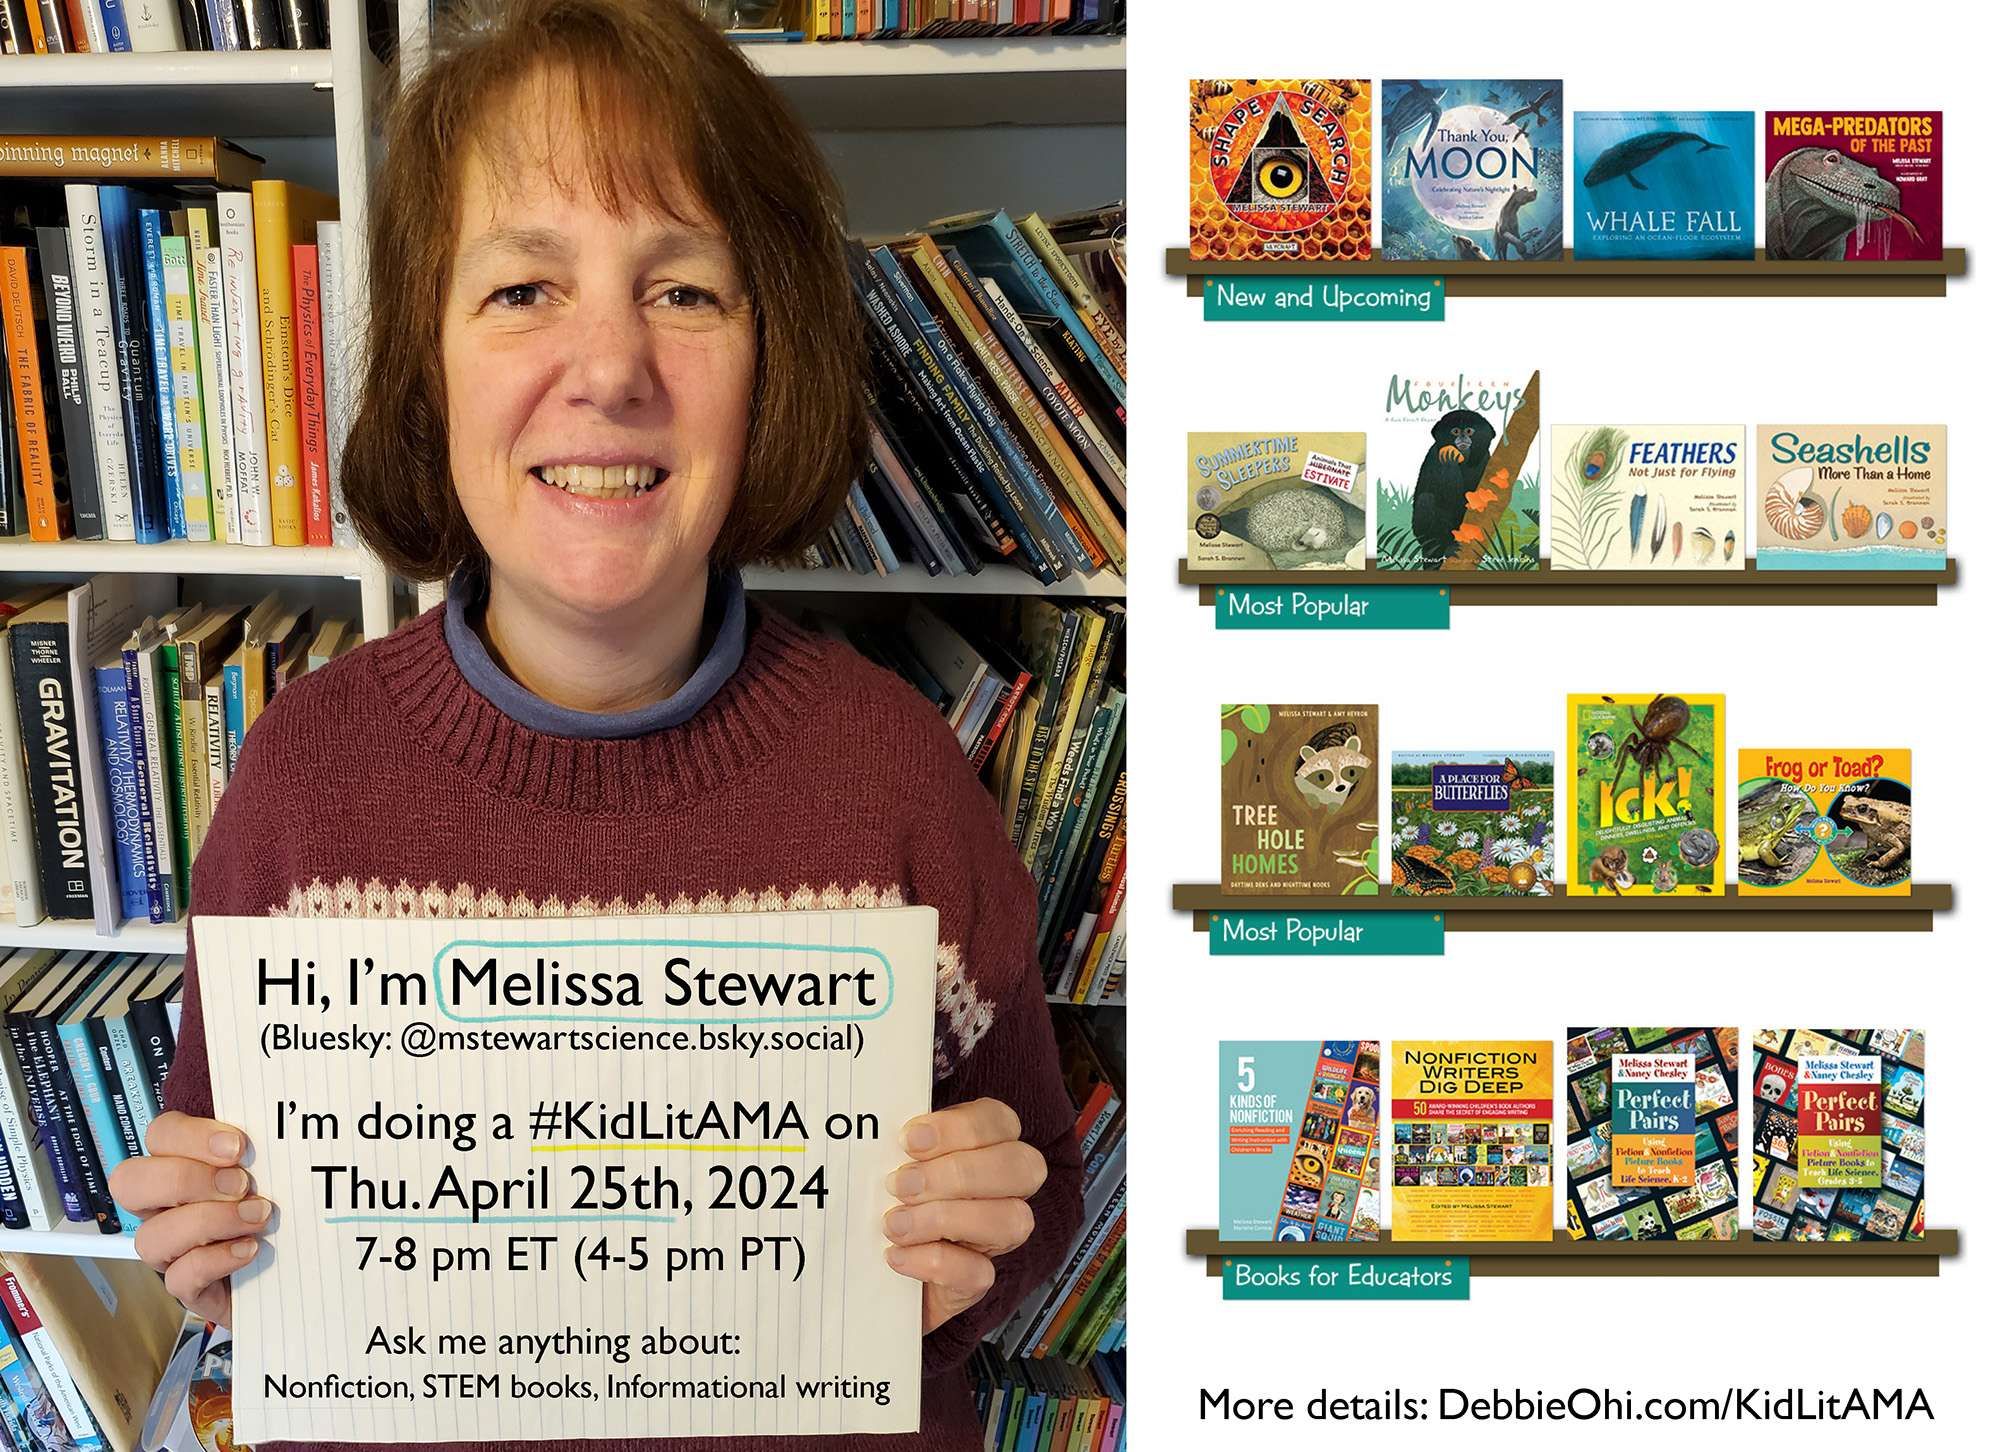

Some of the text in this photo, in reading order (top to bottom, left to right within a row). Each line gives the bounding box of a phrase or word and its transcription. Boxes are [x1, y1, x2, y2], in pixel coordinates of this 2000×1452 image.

[1213, 99, 1262, 168] SHAPE
[1300, 99, 1350, 186] SEARCH
[1438, 128, 1508, 143] Thank You,
[1773, 117, 1932, 137] MEGA-PREDATORS
[71, 141, 139, 165] magnet
[172, 139, 181, 172] MITCHELL
[1851, 139, 1931, 153] OF THE PAST
[1404, 146, 1539, 179] MOON
[1232, 203, 1329, 213] MELISSA STEWART
[1586, 211, 1741, 232] WHALE FALL
[8, 259, 18, 289] DAVID
[81, 214, 112, 393] Storm in a Teacup
[1218, 284, 1431, 312] New and Upcoming
[12, 291, 23, 338] DEUTSCH
[51, 274, 74, 364] BEYOND WEIRD
[866, 289, 913, 359] WASHED ASHORE
[995, 295, 1054, 378] Hands-On Science
[18, 349, 27, 370] THE
[263, 288, 280, 443] and Schrödinger's Cat
[280, 315, 294, 418] Einstein's Dice
[302, 269, 319, 453] The Physics of Everyday Things
[20, 375, 34, 416] FABRIC
[61, 369, 72, 400] BALL
[69, 368, 82, 405] PHILIP
[913, 338, 971, 424] FINDING FAMILY
[1042, 386, 1091, 450] COYOTE MOON
[1386, 374, 1526, 447] Monkeys
[26, 421, 37, 434] OF
[28, 439, 42, 486] REALITY
[1195, 436, 1298, 478] SUMMERTIME
[1629, 442, 1737, 464] FEATHERS
[1771, 432, 1930, 464] Seashells
[1216, 456, 1290, 492] SLEEPERS
[1303, 469, 1350, 490] ESTIVATE
[1629, 467, 1736, 480] Not Just for Flying
[1818, 467, 1931, 480] More Than a Home
[1229, 592, 1369, 621] Most Popular
[207, 694, 222, 769] RELATIVITY
[38, 677, 84, 869] GRAVITATION
[1439, 774, 1500, 784] A PLACE FOR
[1766, 754, 1884, 784] Frog or Toad?
[105, 738, 129, 847] AND COSMOLOGY
[114, 701, 145, 878] RELATIVITY, THERMODYNAMICS
[1042, 741, 1083, 833] Weeds Find Way
[1434, 784, 1508, 800] BUTTERFLIES
[1780, 783, 1870, 793] How Do You Know?
[1233, 805, 1277, 825] TREE
[1258, 829, 1304, 850] HOLE
[1233, 854, 1298, 874] HOMES
[1223, 918, 1364, 947] Most Popular
[259, 958, 876, 1013] Hi, I'm Melissa Stewart
[261, 1022, 863, 1058] (Bluesky: @mstewartscience.bsky.social)
[1238, 1056, 1256, 1092] 5
[1405, 1051, 1537, 1065] NONFICTION
[1424, 1067, 1519, 1079] WRITERS
[1618, 1059, 1688, 1068] Melissa Stewart
[1230, 1095, 1276, 1108] KINDS OF
[1420, 1081, 1524, 1093] DIG DEEP
[1616, 1088, 1691, 1111] Perfect
[39, 1030, 98, 1195] HOOPER AT THE EDGE OF TIME
[278, 1101, 878, 1151] I'm doing a #KidLitAMA on
[1230, 1110, 1293, 1123] NONFICTION
[1629, 1110, 1679, 1131] Pairs
[311, 1165, 828, 1223] Thu. April 25th, 2024
[356, 1236, 805, 1281] 7-8 pm ET (4-5 pm PT)
[1236, 1263, 1452, 1286] Books for Educators
[5, 1276, 30, 1318] Frommer's
[366, 1326, 740, 1363] Ask me anything about:
[265, 1374, 890, 1405] Nonfiction, STEM books, Informational writing
